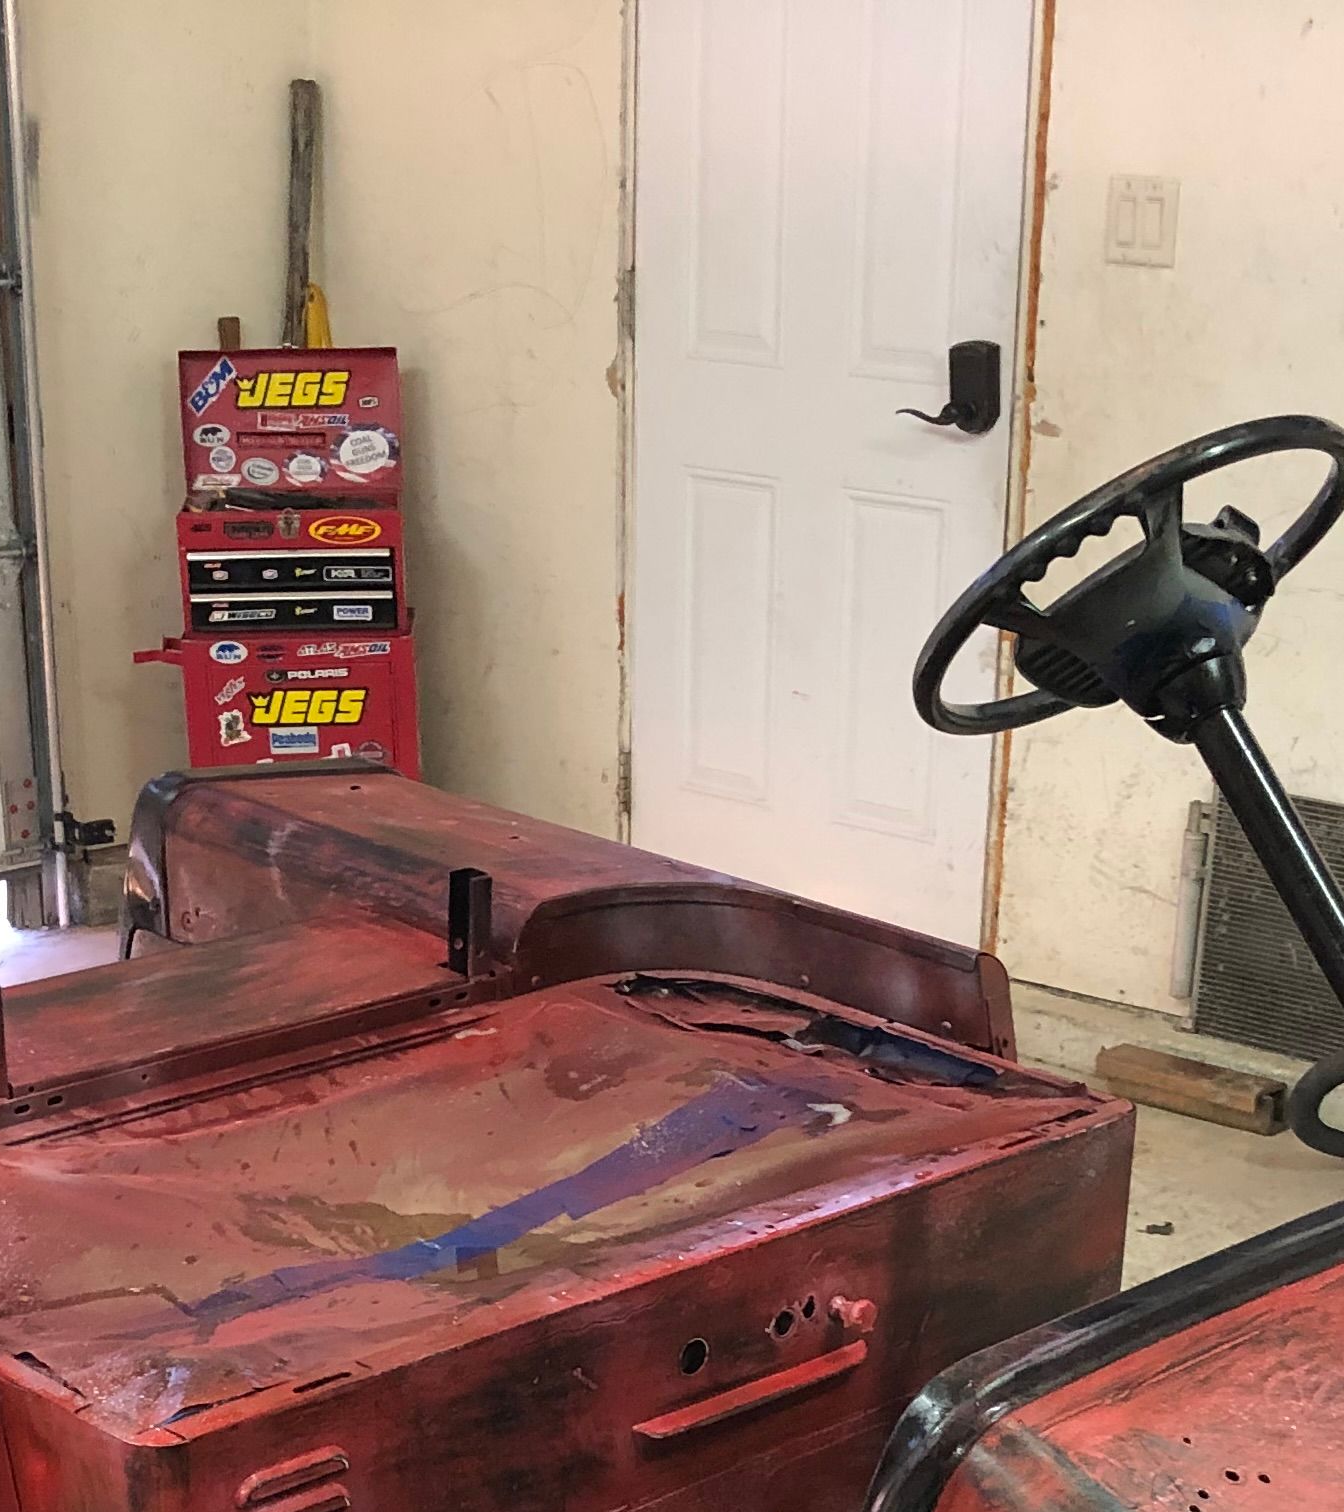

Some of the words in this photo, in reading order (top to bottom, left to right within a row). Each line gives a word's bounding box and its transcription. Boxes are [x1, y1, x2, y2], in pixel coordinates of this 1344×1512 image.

[237, 371, 349, 407] JEGS
[346, 450, 386, 466] FREEDOM
[316, 522, 376, 537] FMF
[336, 607, 369, 615] POWER
[287, 668, 348, 679] POLARIS
[252, 689, 366, 723] JEGS
